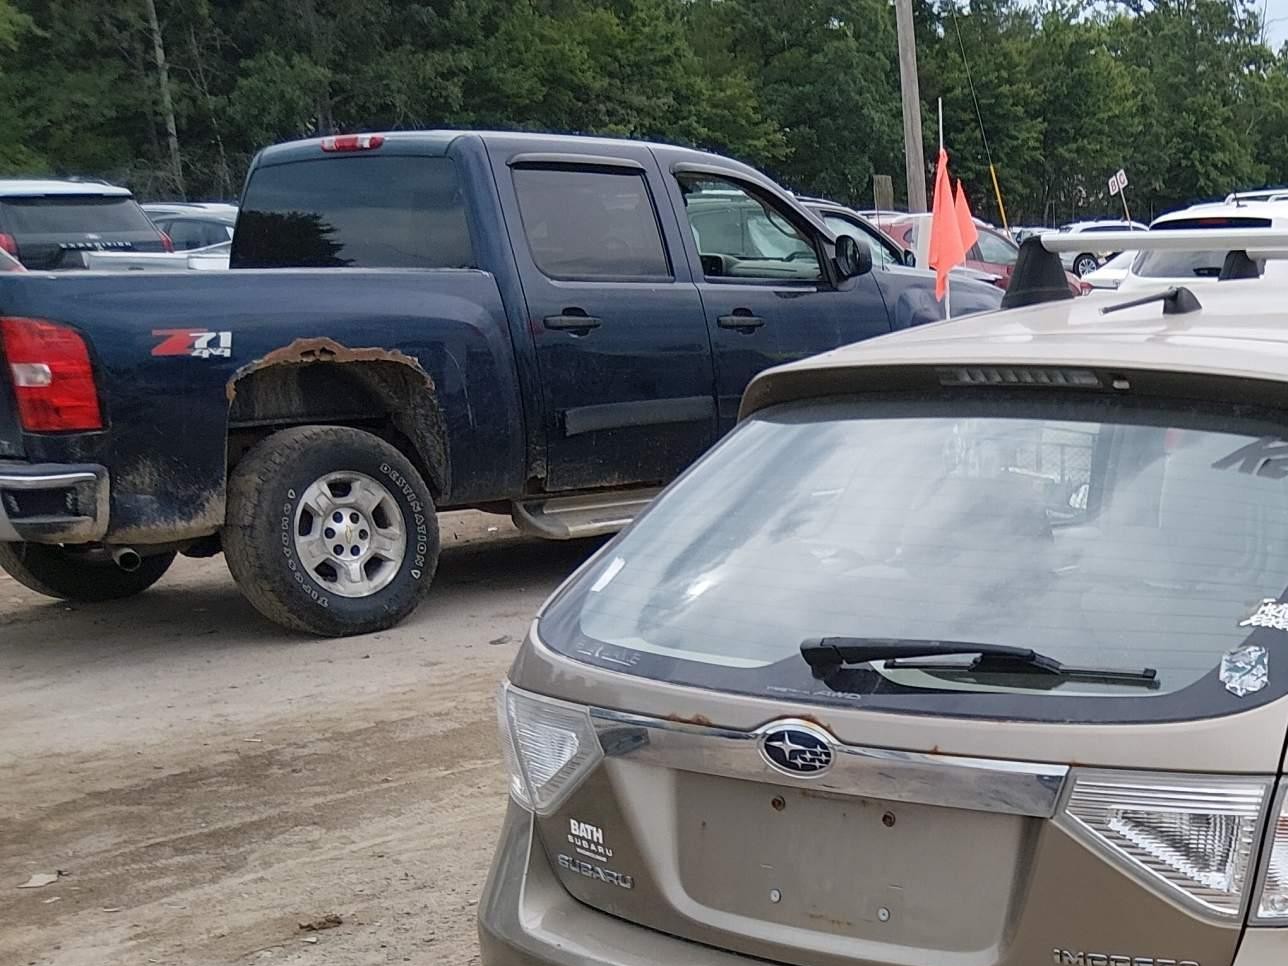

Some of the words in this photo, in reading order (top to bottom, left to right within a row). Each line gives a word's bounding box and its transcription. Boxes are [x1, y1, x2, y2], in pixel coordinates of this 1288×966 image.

[151, 328, 232, 356] Z71
[379, 462, 427, 569] DESTINATION
[569, 818, 604, 844] BATH
[567, 834, 613, 857] SUBARU
[558, 853, 632, 889] SUBARU
